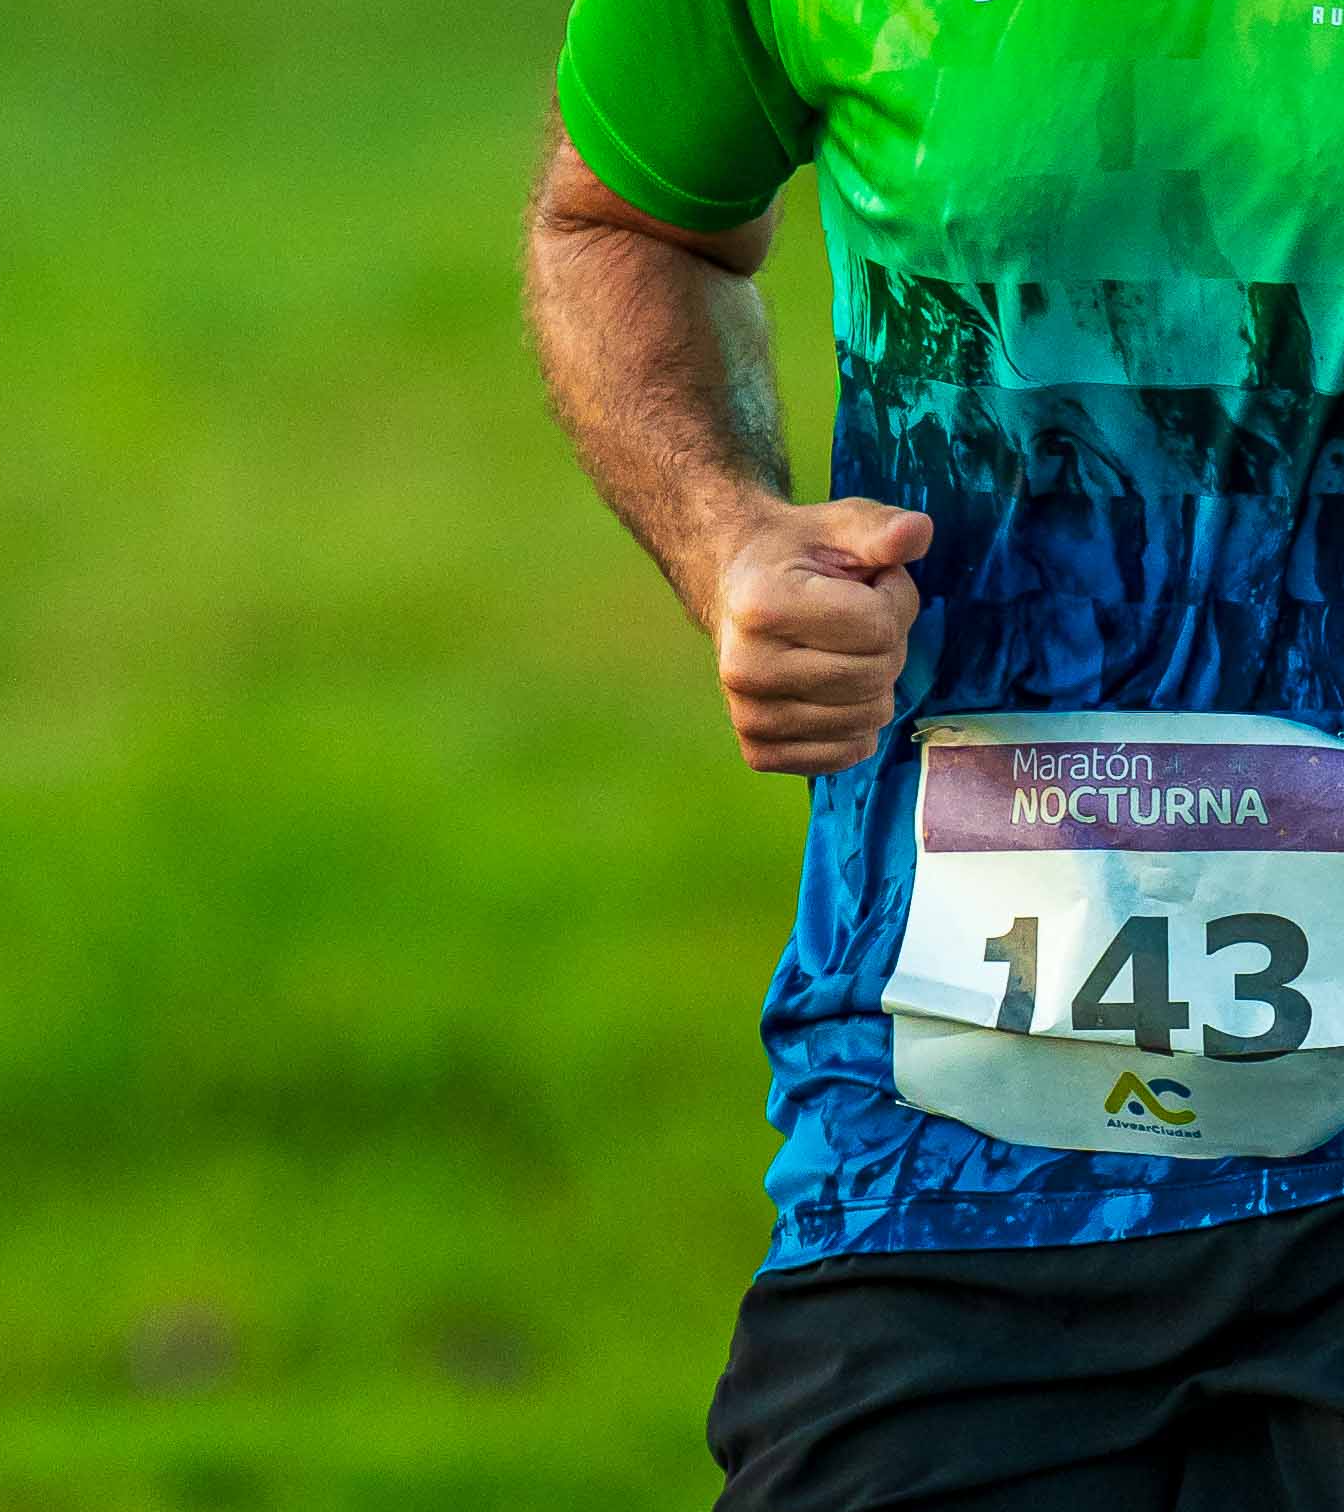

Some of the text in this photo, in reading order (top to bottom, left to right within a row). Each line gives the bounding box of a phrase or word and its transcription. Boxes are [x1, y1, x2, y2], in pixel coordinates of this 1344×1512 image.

[1013, 743, 1153, 780] Maratón
[1011, 786, 1269, 825] NOCTURNA
[984, 913, 1312, 1062] 143
